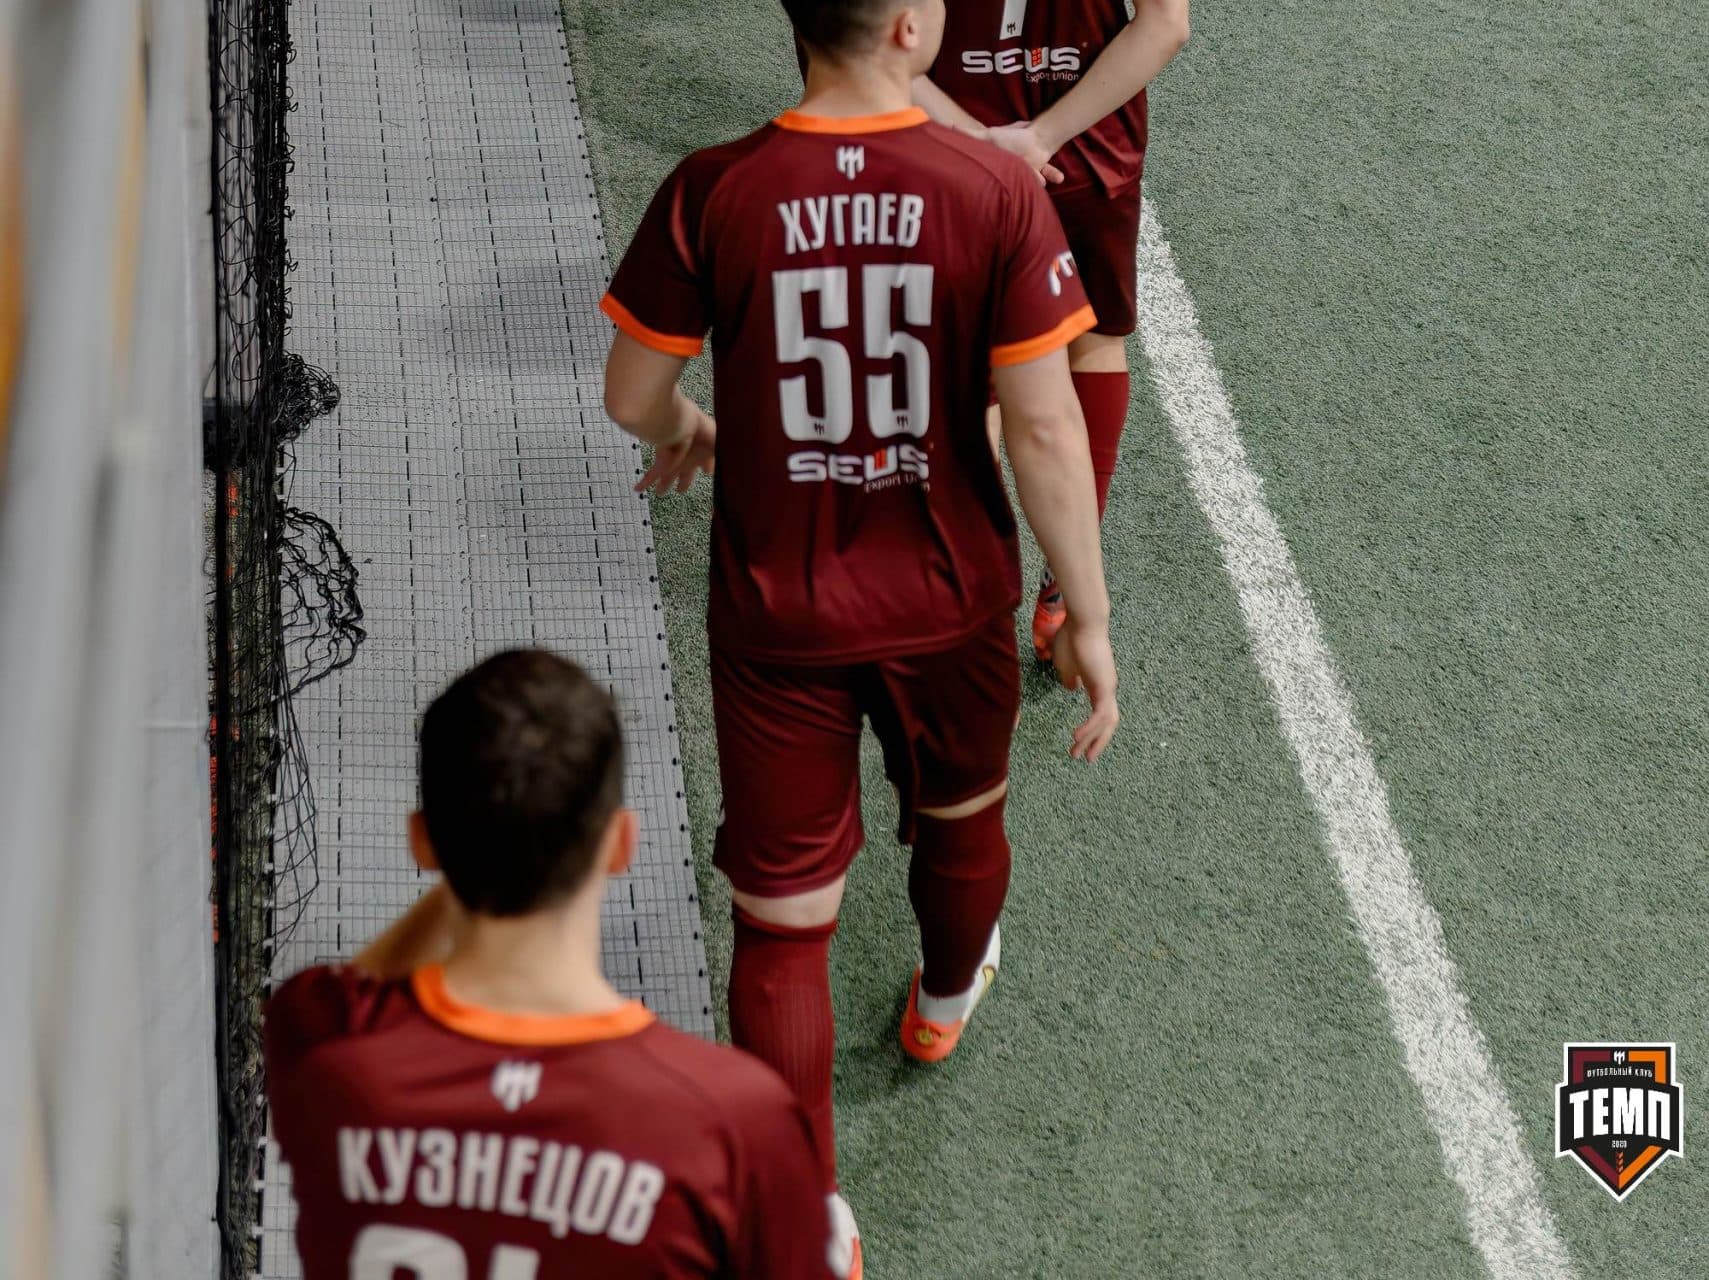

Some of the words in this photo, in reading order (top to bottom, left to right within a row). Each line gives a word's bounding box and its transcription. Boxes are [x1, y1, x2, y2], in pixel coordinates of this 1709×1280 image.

[961, 46, 1081, 74] SEUS
[1052, 71, 1079, 81] Union
[777, 193, 925, 255] ХУГАЕВ
[771, 263, 934, 444] 55
[787, 443, 929, 485] SEUS
[864, 473, 901, 493] Export
[336, 1126, 666, 1246] КУЗНЕЦОВ
